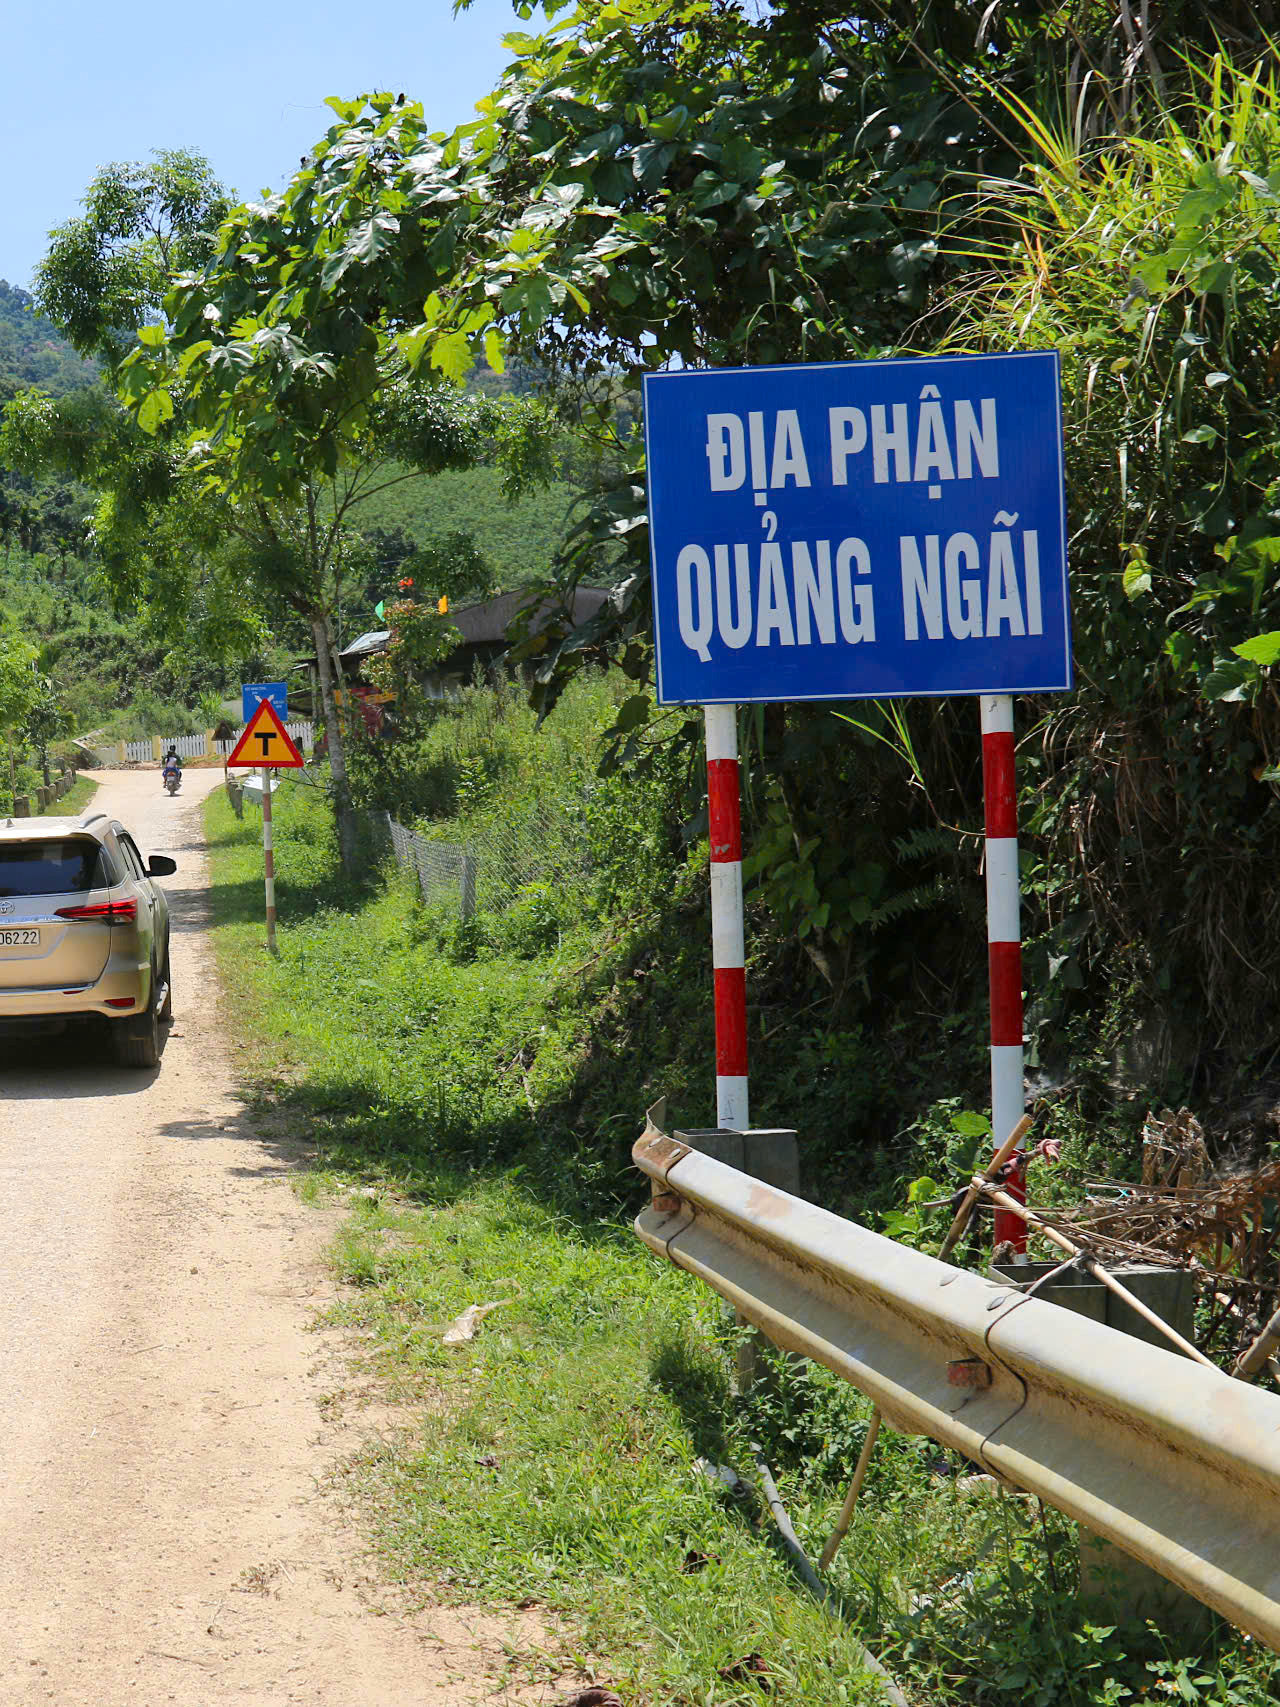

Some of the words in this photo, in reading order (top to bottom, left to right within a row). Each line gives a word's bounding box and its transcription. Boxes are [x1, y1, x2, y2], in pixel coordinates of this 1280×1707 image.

[706, 409, 811, 506] ĐỊA
[829, 384, 1000, 499] PHẬN
[676, 510, 876, 662] QUẢNG
[900, 510, 1044, 642] NGÃI
